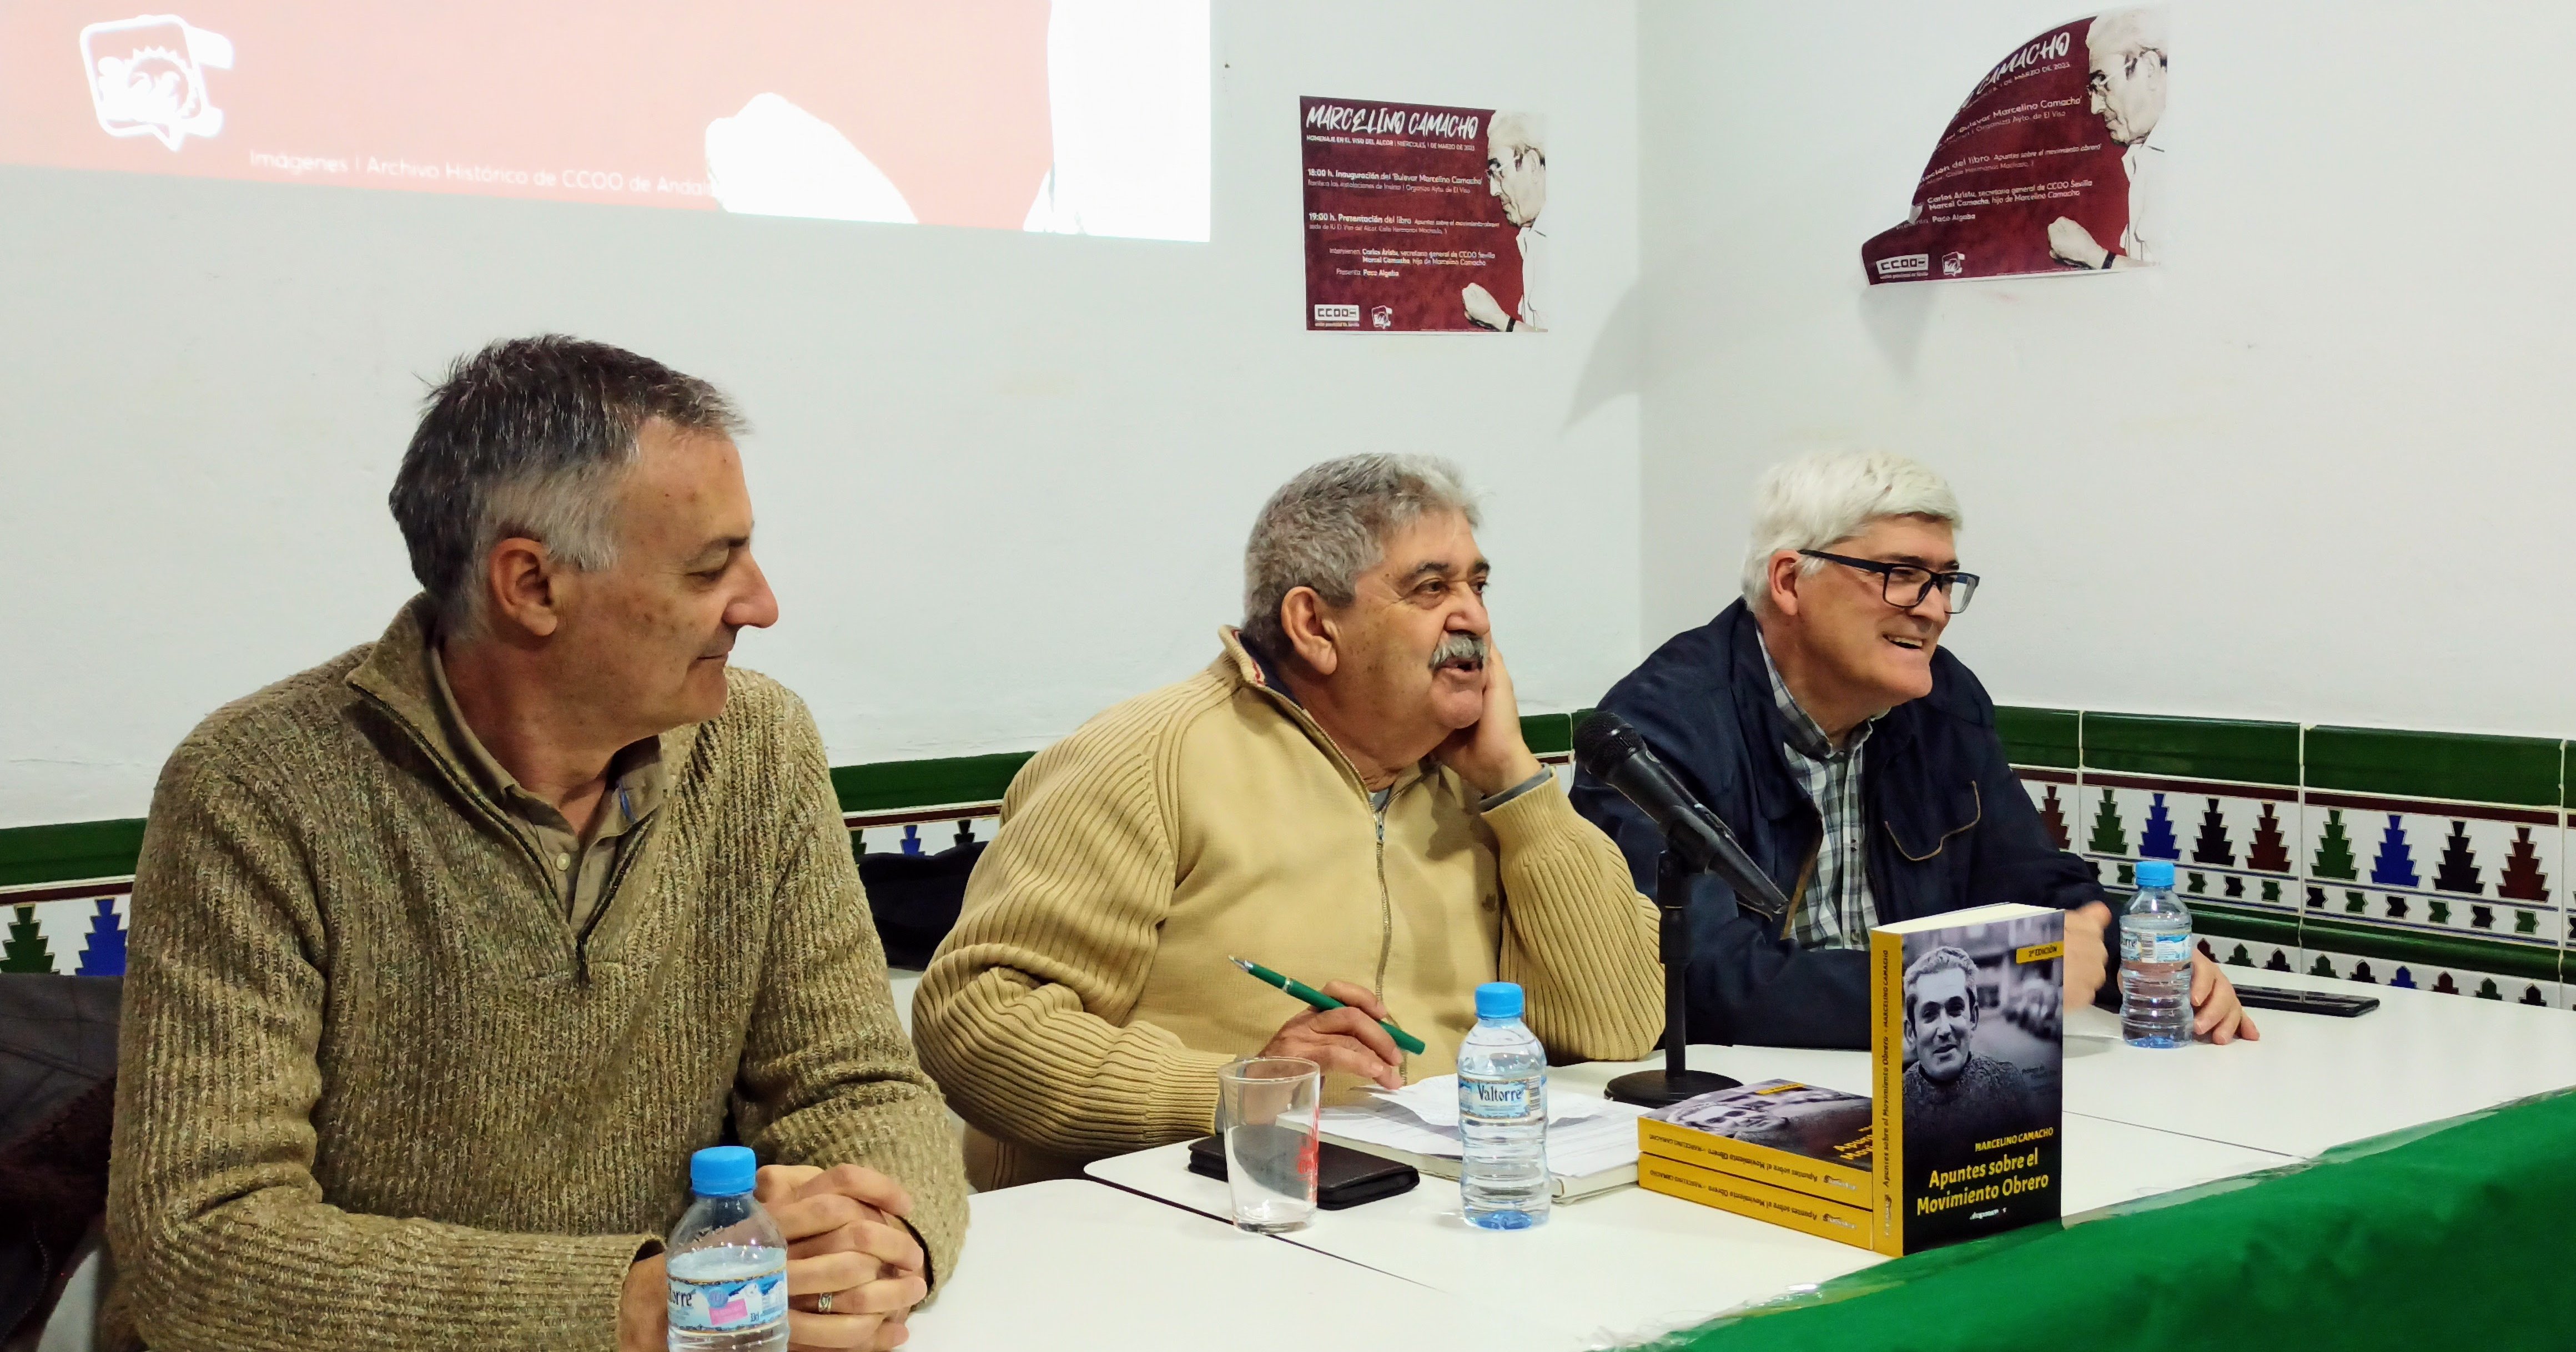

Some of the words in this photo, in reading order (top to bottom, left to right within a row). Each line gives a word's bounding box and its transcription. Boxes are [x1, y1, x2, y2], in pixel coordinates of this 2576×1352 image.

[1976, 32, 2070, 94] CAMACHO
[1993, 101, 2038, 118] Marcelino
[1306, 104, 1406, 135] MARCELINO
[1408, 112, 1479, 140] CAMACHO
[249, 149, 349, 176] Imágenes
[366, 155, 440, 179] Archivo
[445, 161, 529, 185] Histórico
[533, 169, 556, 187] de
[562, 169, 625, 191] CCOO
[628, 176, 652, 192] de
[1951, 157, 1966, 169] del
[1968, 155, 1990, 164] libro
[1927, 194, 1953, 204] Carlos
[2011, 184, 2036, 196] general
[2046, 181, 2069, 190] CCOO
[1929, 200, 1955, 211] Marcel
[1991, 195, 2004, 205] hijo
[2014, 192, 2046, 203] Marcelino
[2047, 189, 2080, 199] Camacho
[1952, 213, 1975, 222] Algaba
[1477, 1083, 1522, 1102] Valtorre
[1975, 1134, 2017, 1152] MARCELINO
[2018, 1127, 2054, 1143] CAMACHO
[1929, 1163, 1986, 1190] Apuntes
[1988, 1154, 2024, 1175] sobre
[2026, 1147, 2038, 1166] el
[1917, 1185, 1999, 1215] Movimiento
[2002, 1174, 2049, 1196] Obrero
